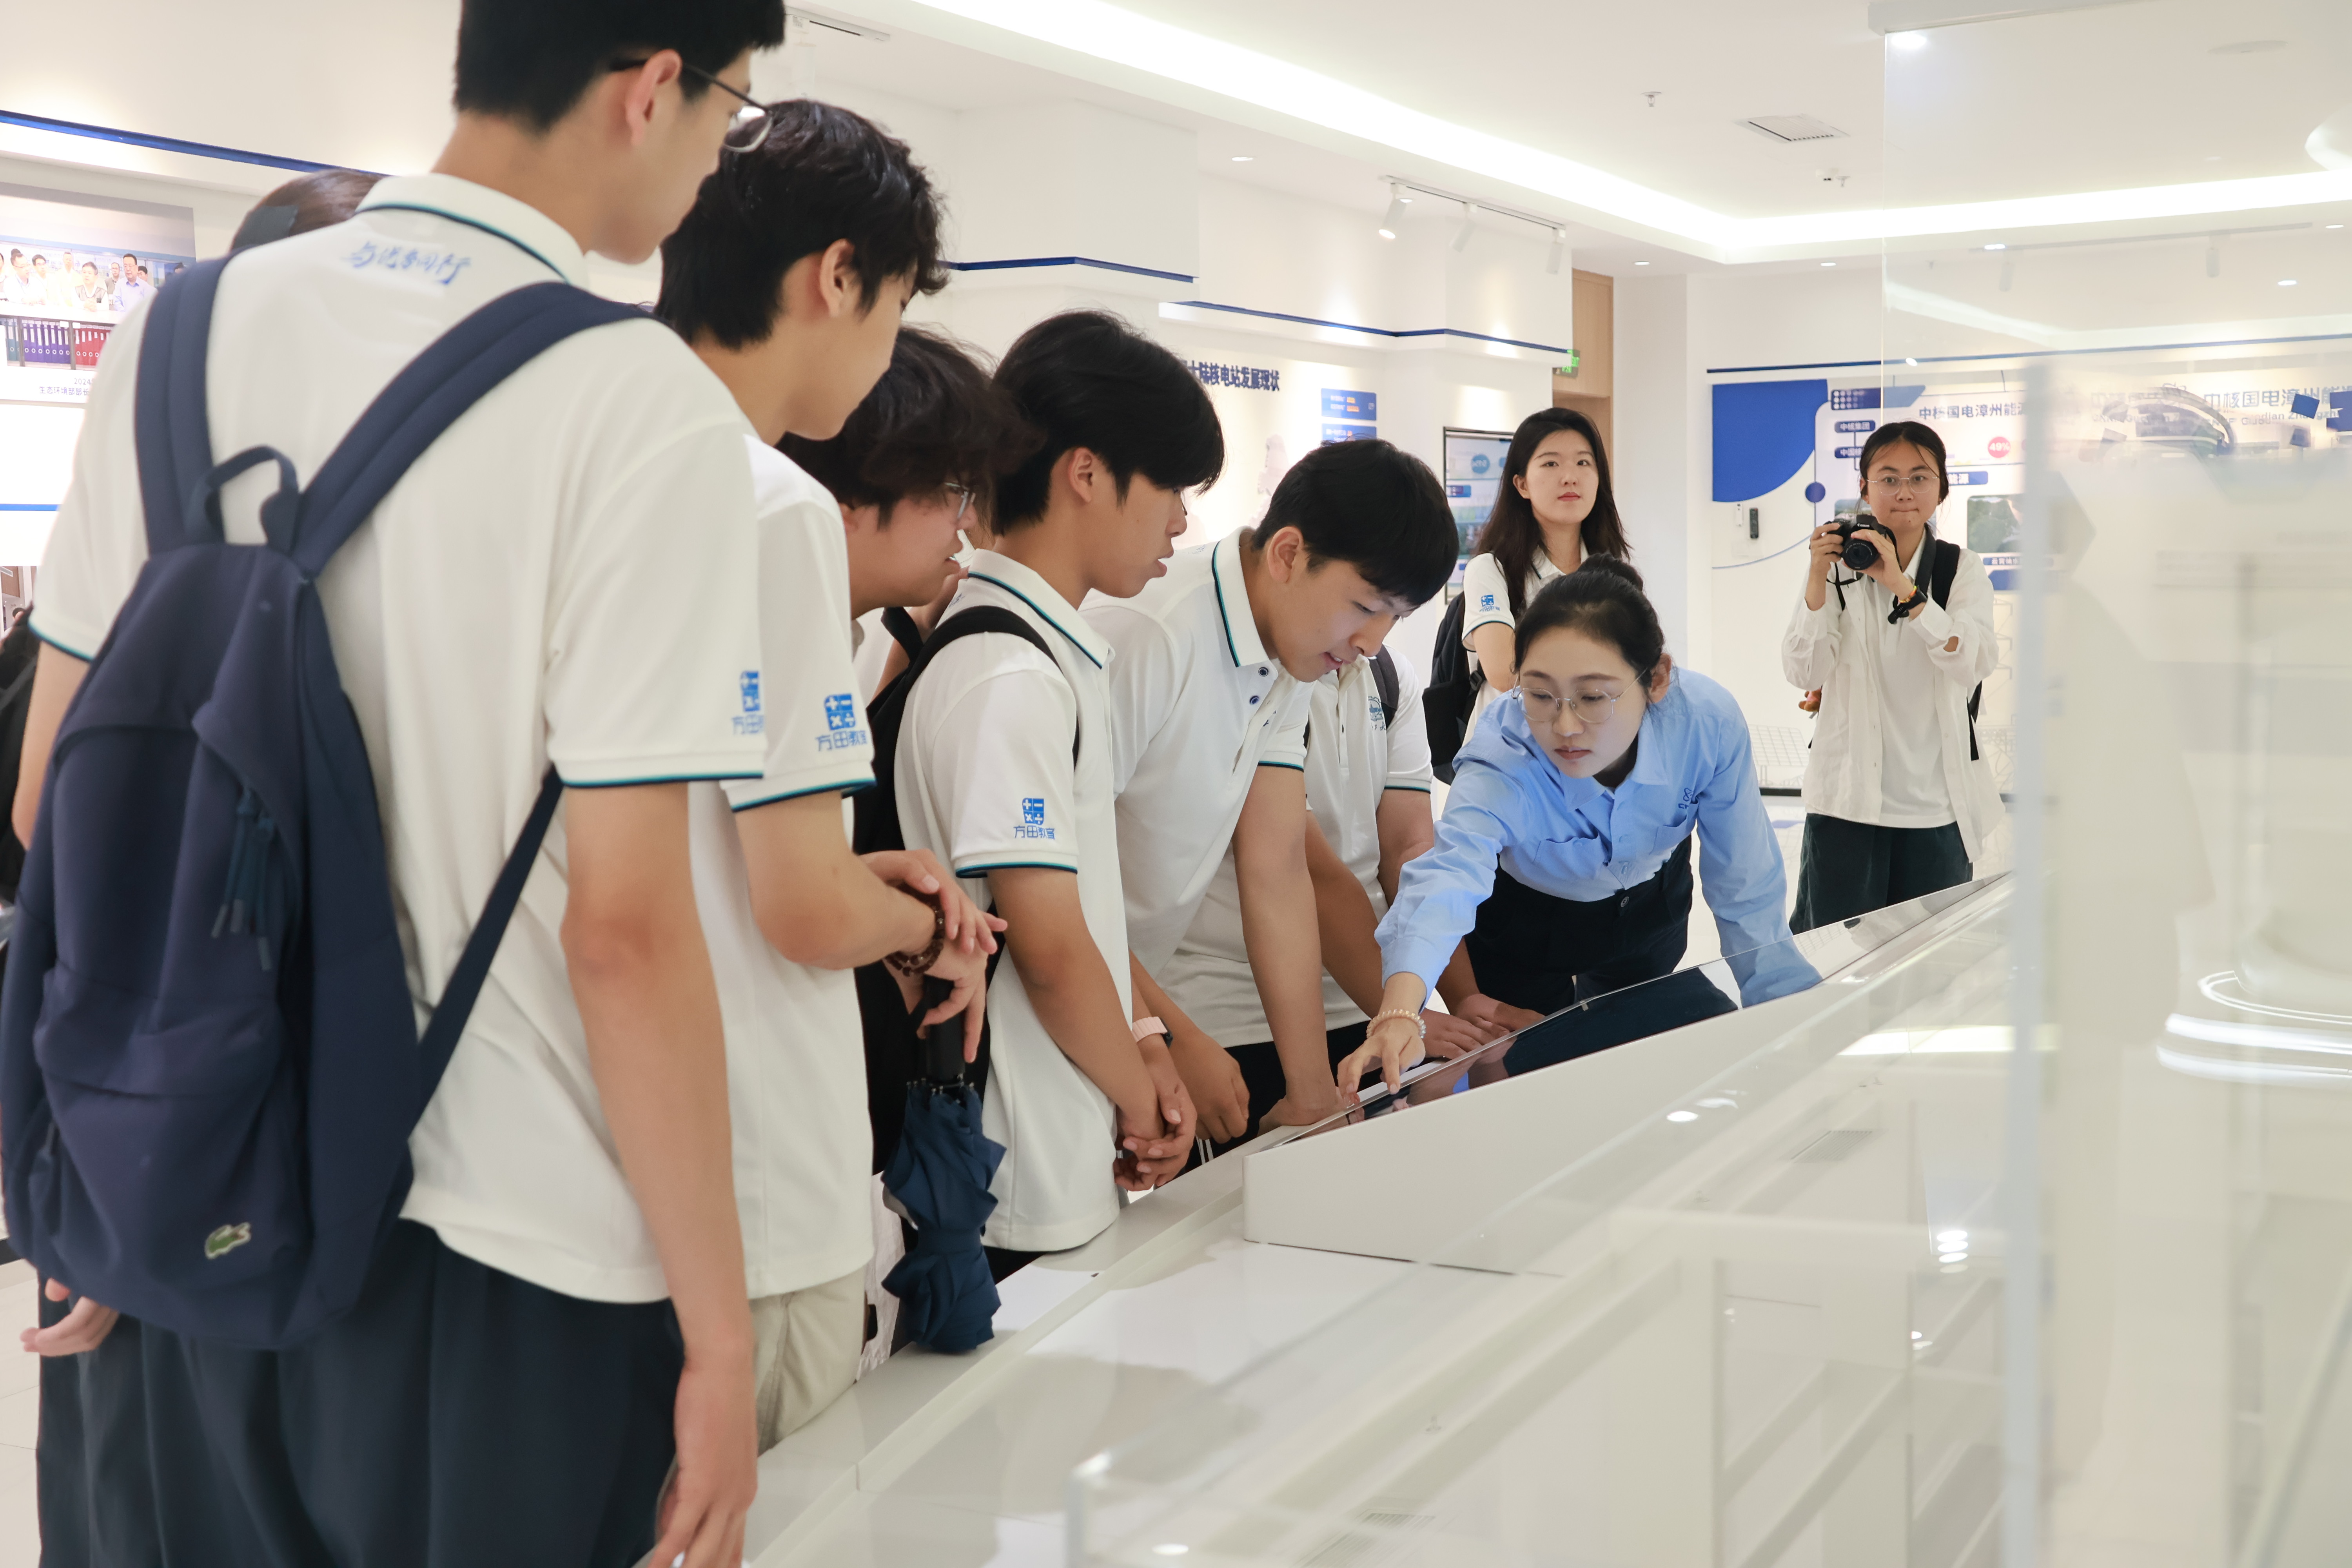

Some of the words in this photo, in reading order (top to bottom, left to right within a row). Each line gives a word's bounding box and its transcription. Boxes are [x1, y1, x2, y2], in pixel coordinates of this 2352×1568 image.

[1989, 442, 2010, 451] 49%
[731, 714, 764, 735] 方田
[1013, 825, 1055, 840] 方田教育
